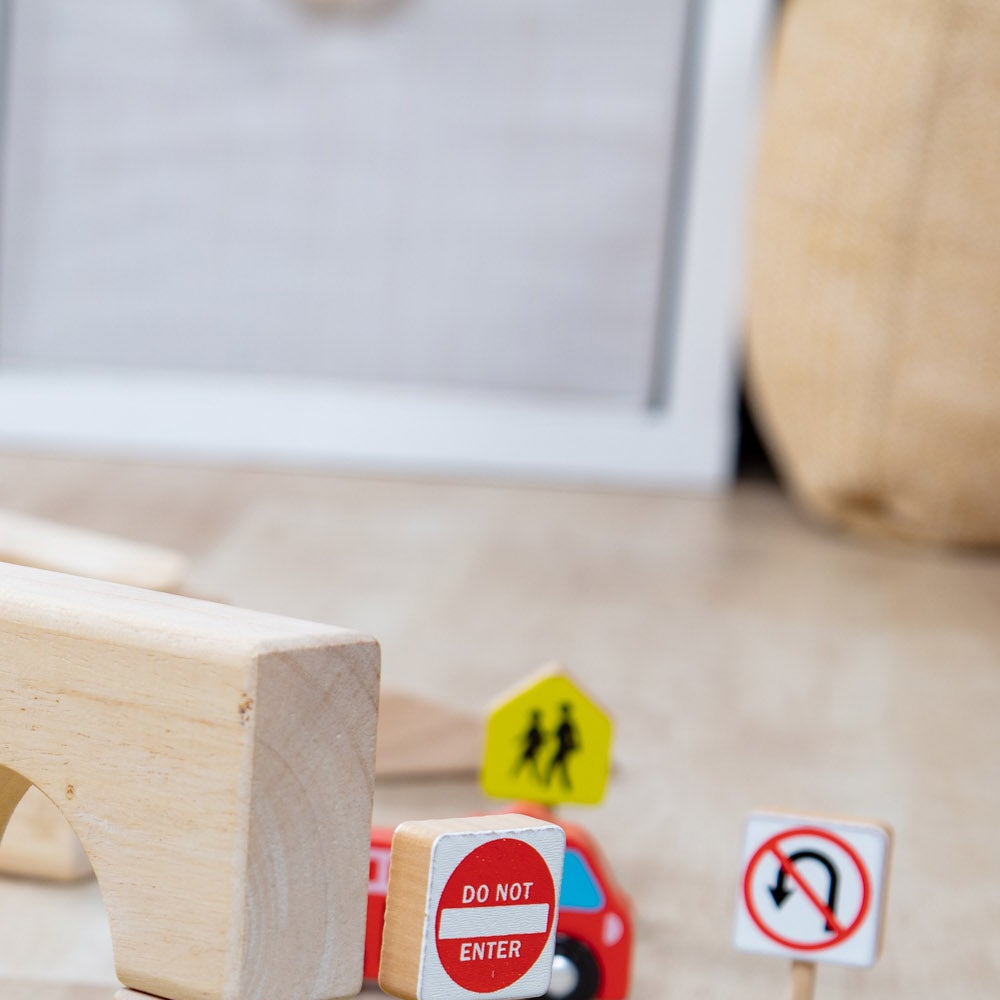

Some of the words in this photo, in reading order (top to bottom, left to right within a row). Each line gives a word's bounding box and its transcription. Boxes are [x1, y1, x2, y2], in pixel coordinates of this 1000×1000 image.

[462, 884, 490, 904] DO
[496, 882, 534, 901] NOT
[459, 940, 522, 962] ENTER
